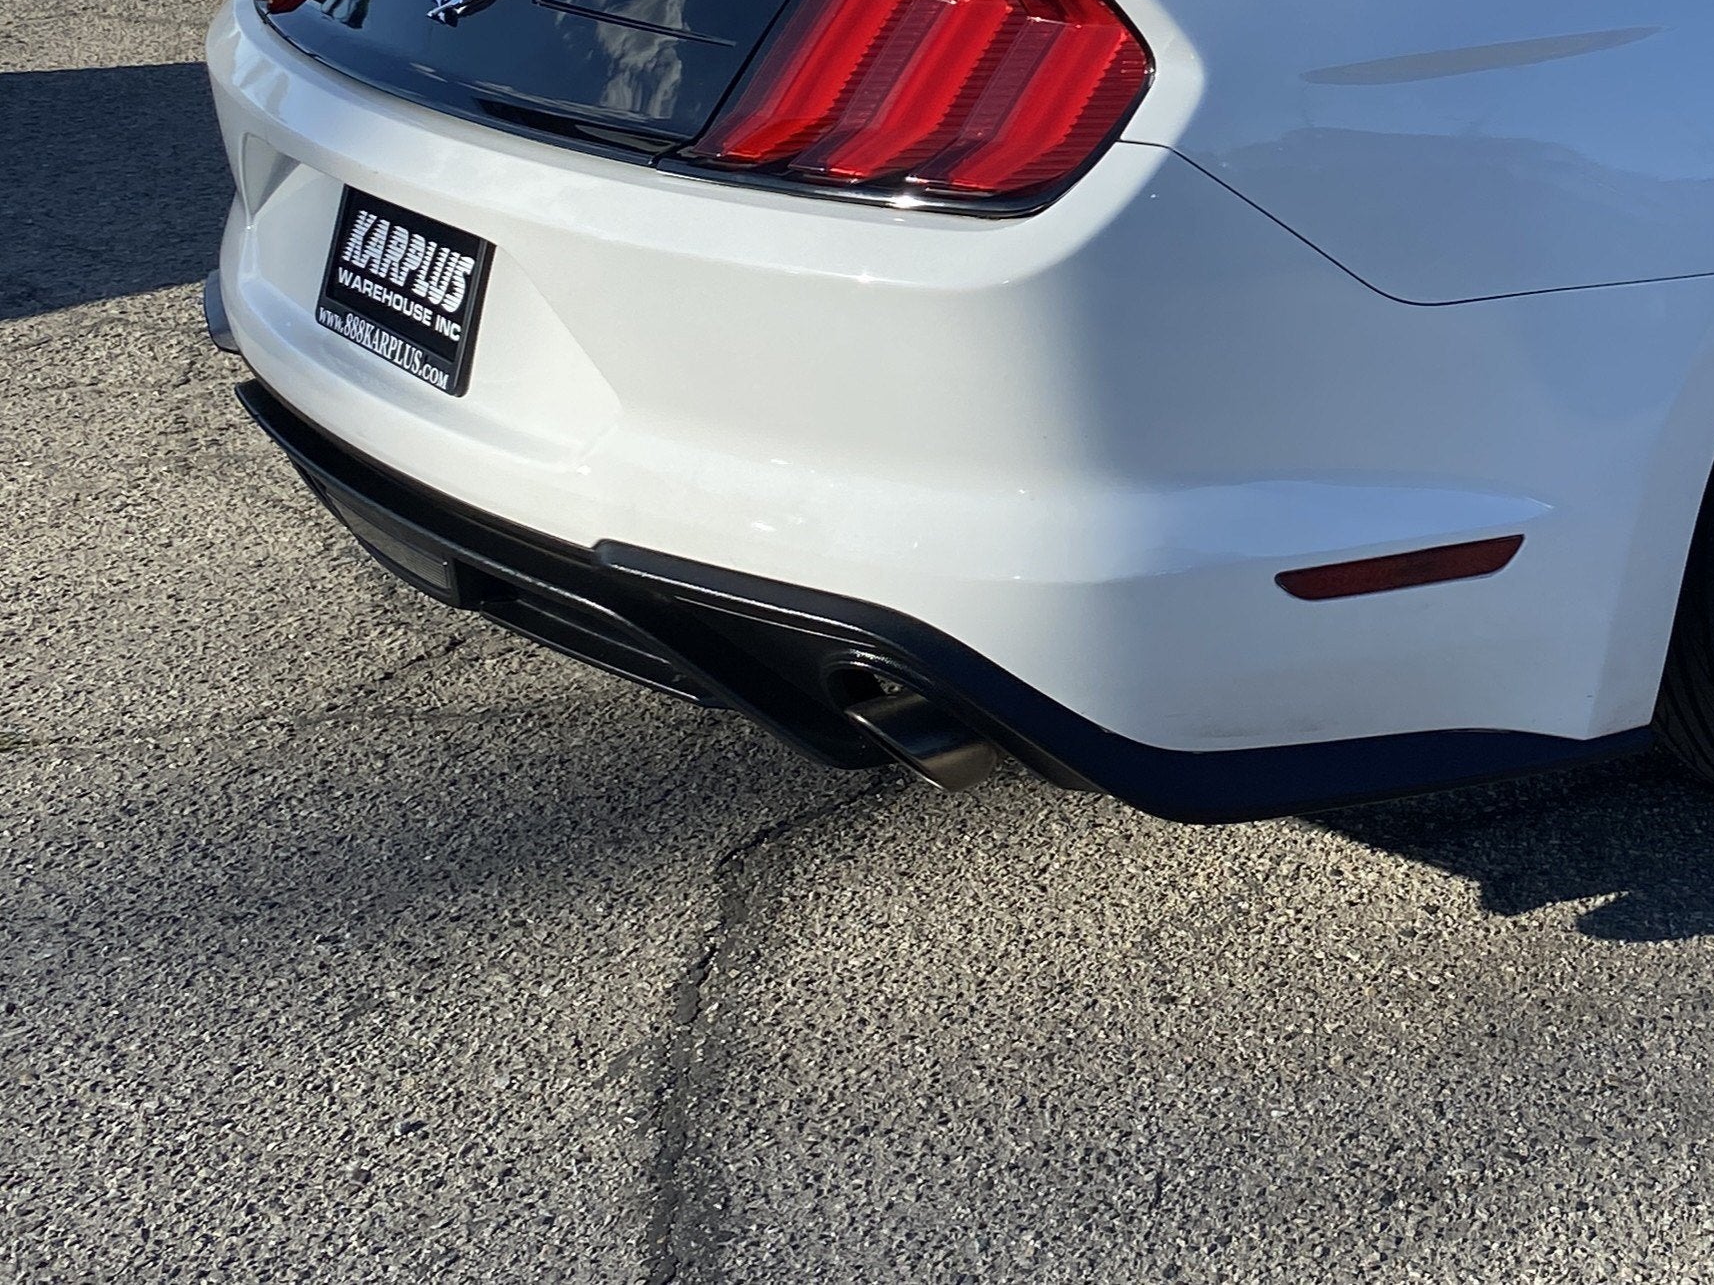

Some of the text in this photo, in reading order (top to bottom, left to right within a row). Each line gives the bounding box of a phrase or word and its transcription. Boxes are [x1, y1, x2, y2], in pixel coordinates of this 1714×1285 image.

[338, 267, 462, 341] WAREHOUSE INC
[341, 210, 475, 313] KARPLUS
